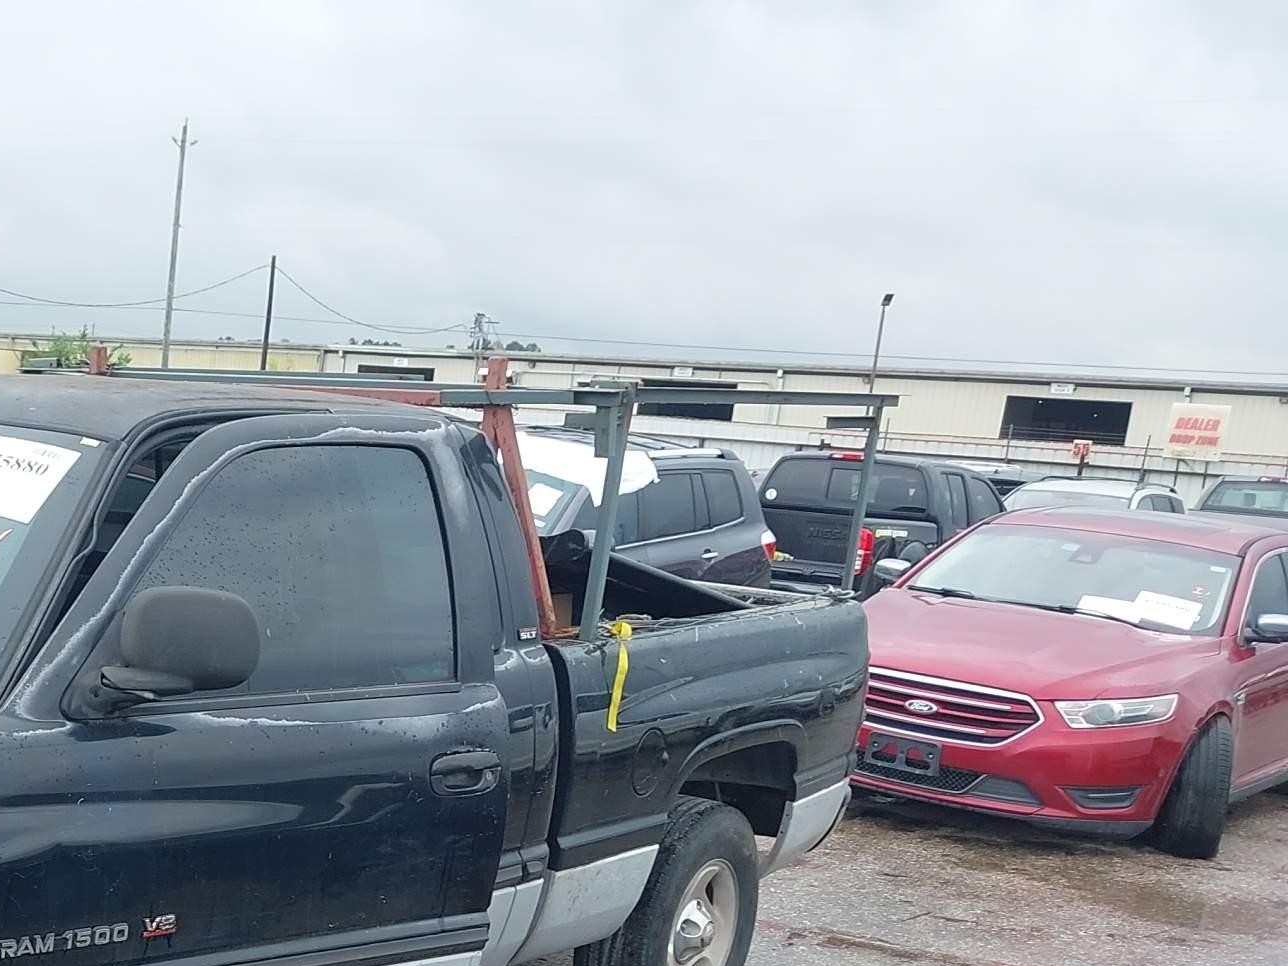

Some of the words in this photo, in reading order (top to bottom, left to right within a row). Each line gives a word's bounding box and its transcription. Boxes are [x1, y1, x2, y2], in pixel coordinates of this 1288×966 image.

[1175, 417, 1221, 431] DEALER
[520, 631, 536, 640] SLT
[143, 914, 176, 931] V8
[0, 932, 55, 959] RAM
[61, 922, 129, 951] 1500
